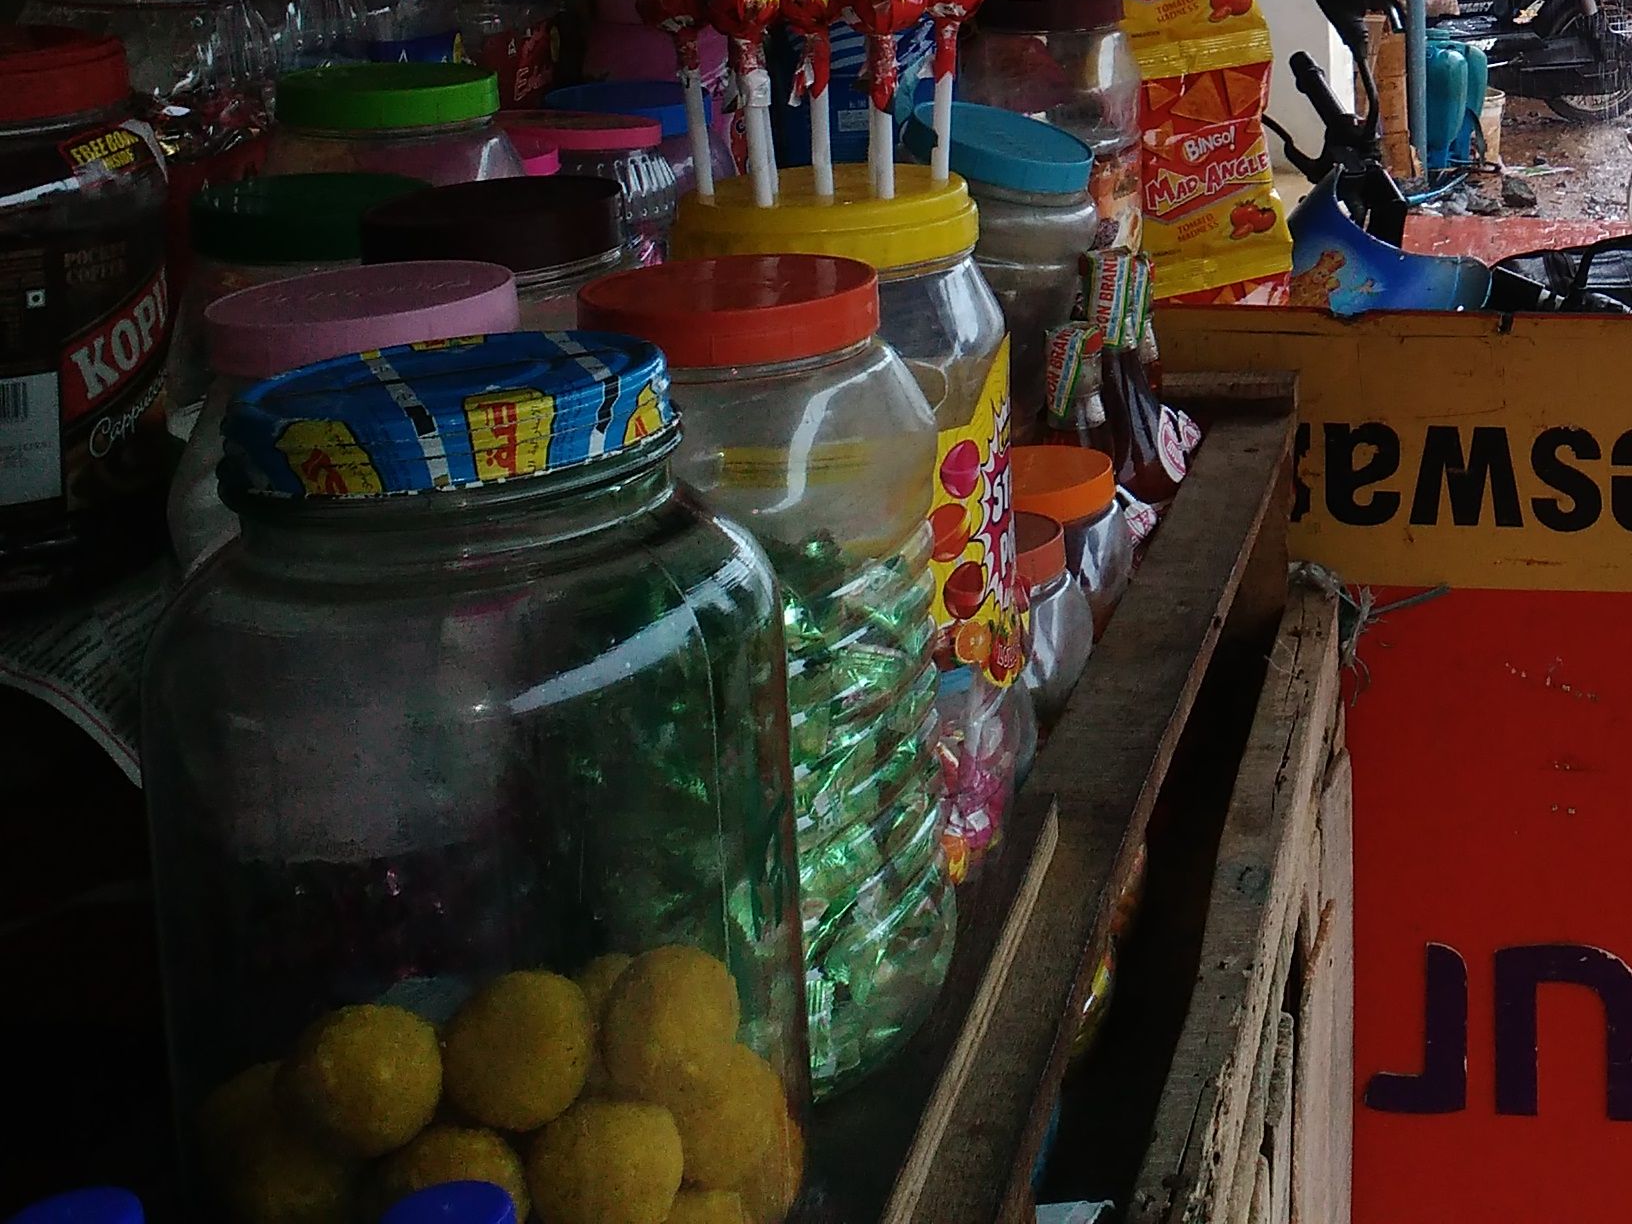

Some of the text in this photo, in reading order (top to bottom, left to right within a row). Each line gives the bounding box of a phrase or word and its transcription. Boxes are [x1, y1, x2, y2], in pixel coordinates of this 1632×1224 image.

[1184, 126, 1236, 163] BINGO!
[1145, 153, 1269, 211] MAD ANGLE
[71, 262, 169, 401] KOPI
